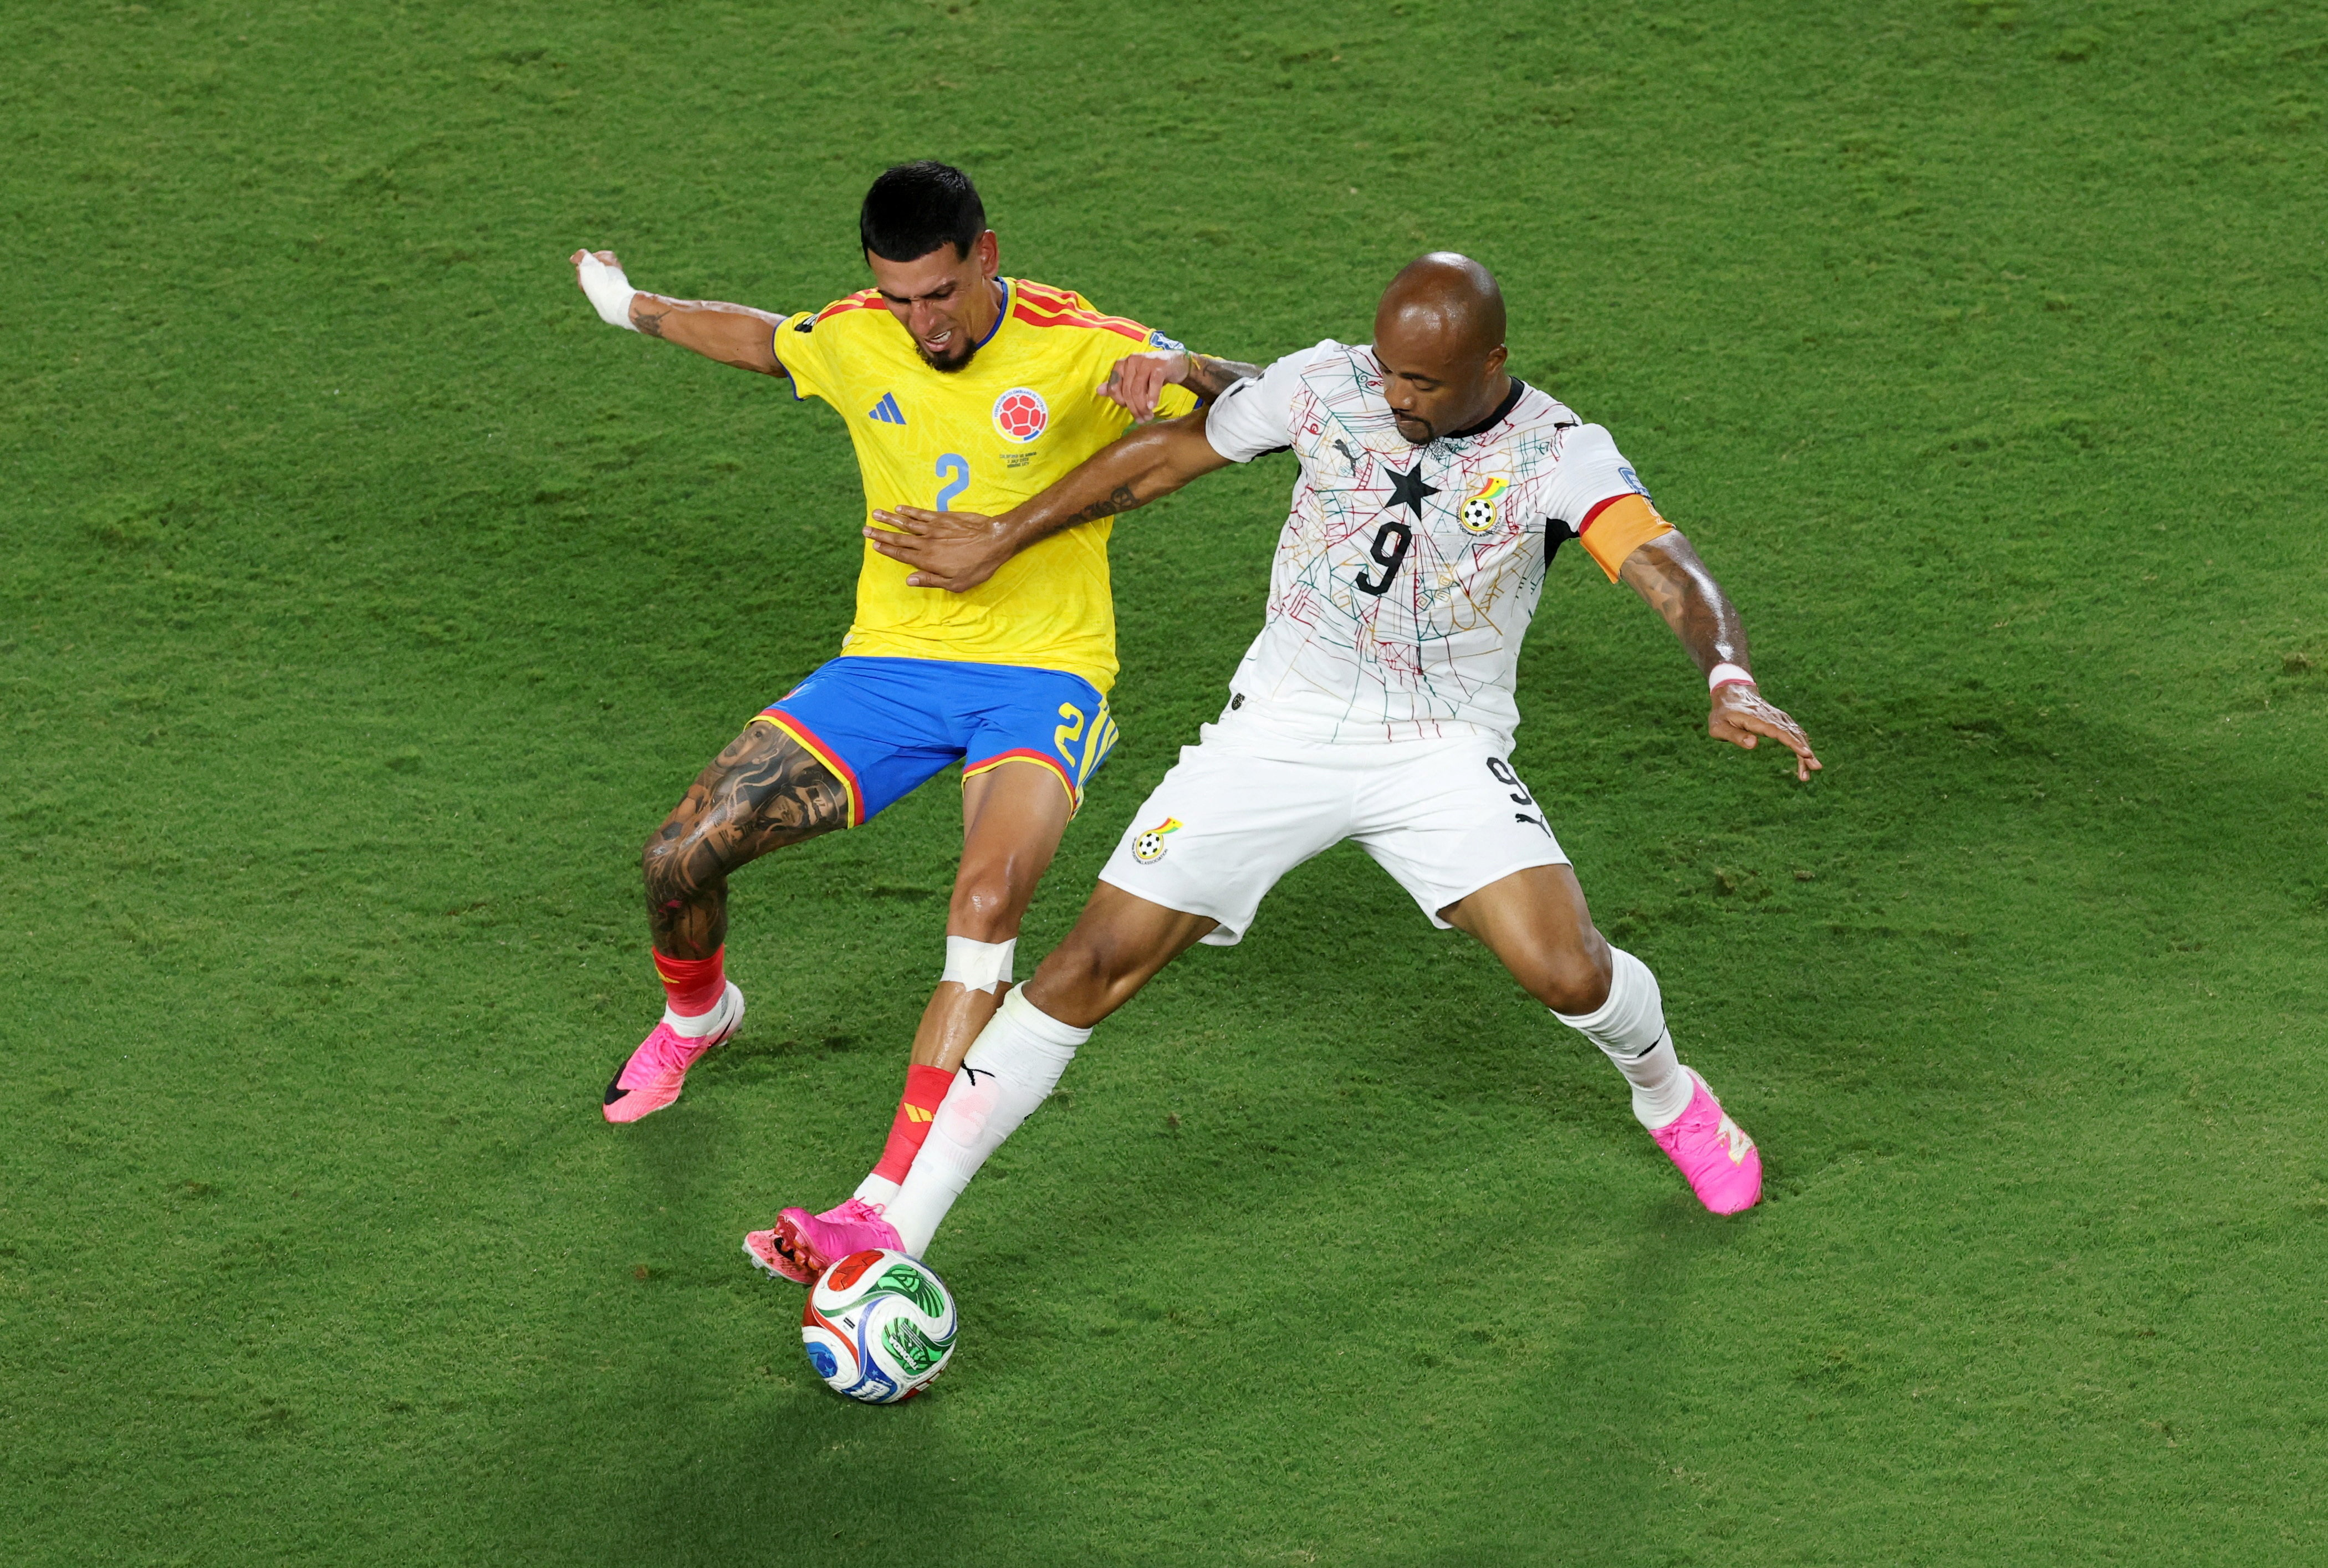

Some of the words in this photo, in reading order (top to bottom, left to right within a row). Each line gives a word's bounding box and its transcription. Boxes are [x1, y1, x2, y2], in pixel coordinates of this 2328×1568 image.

[1432, 445, 1446, 457] 2026
[936, 453, 969, 512] 2
[1356, 521, 1413, 596] 9
[1054, 702, 1085, 768] 2
[1486, 757, 1533, 805] 9
[889, 1334, 919, 1371] TRIONDA
